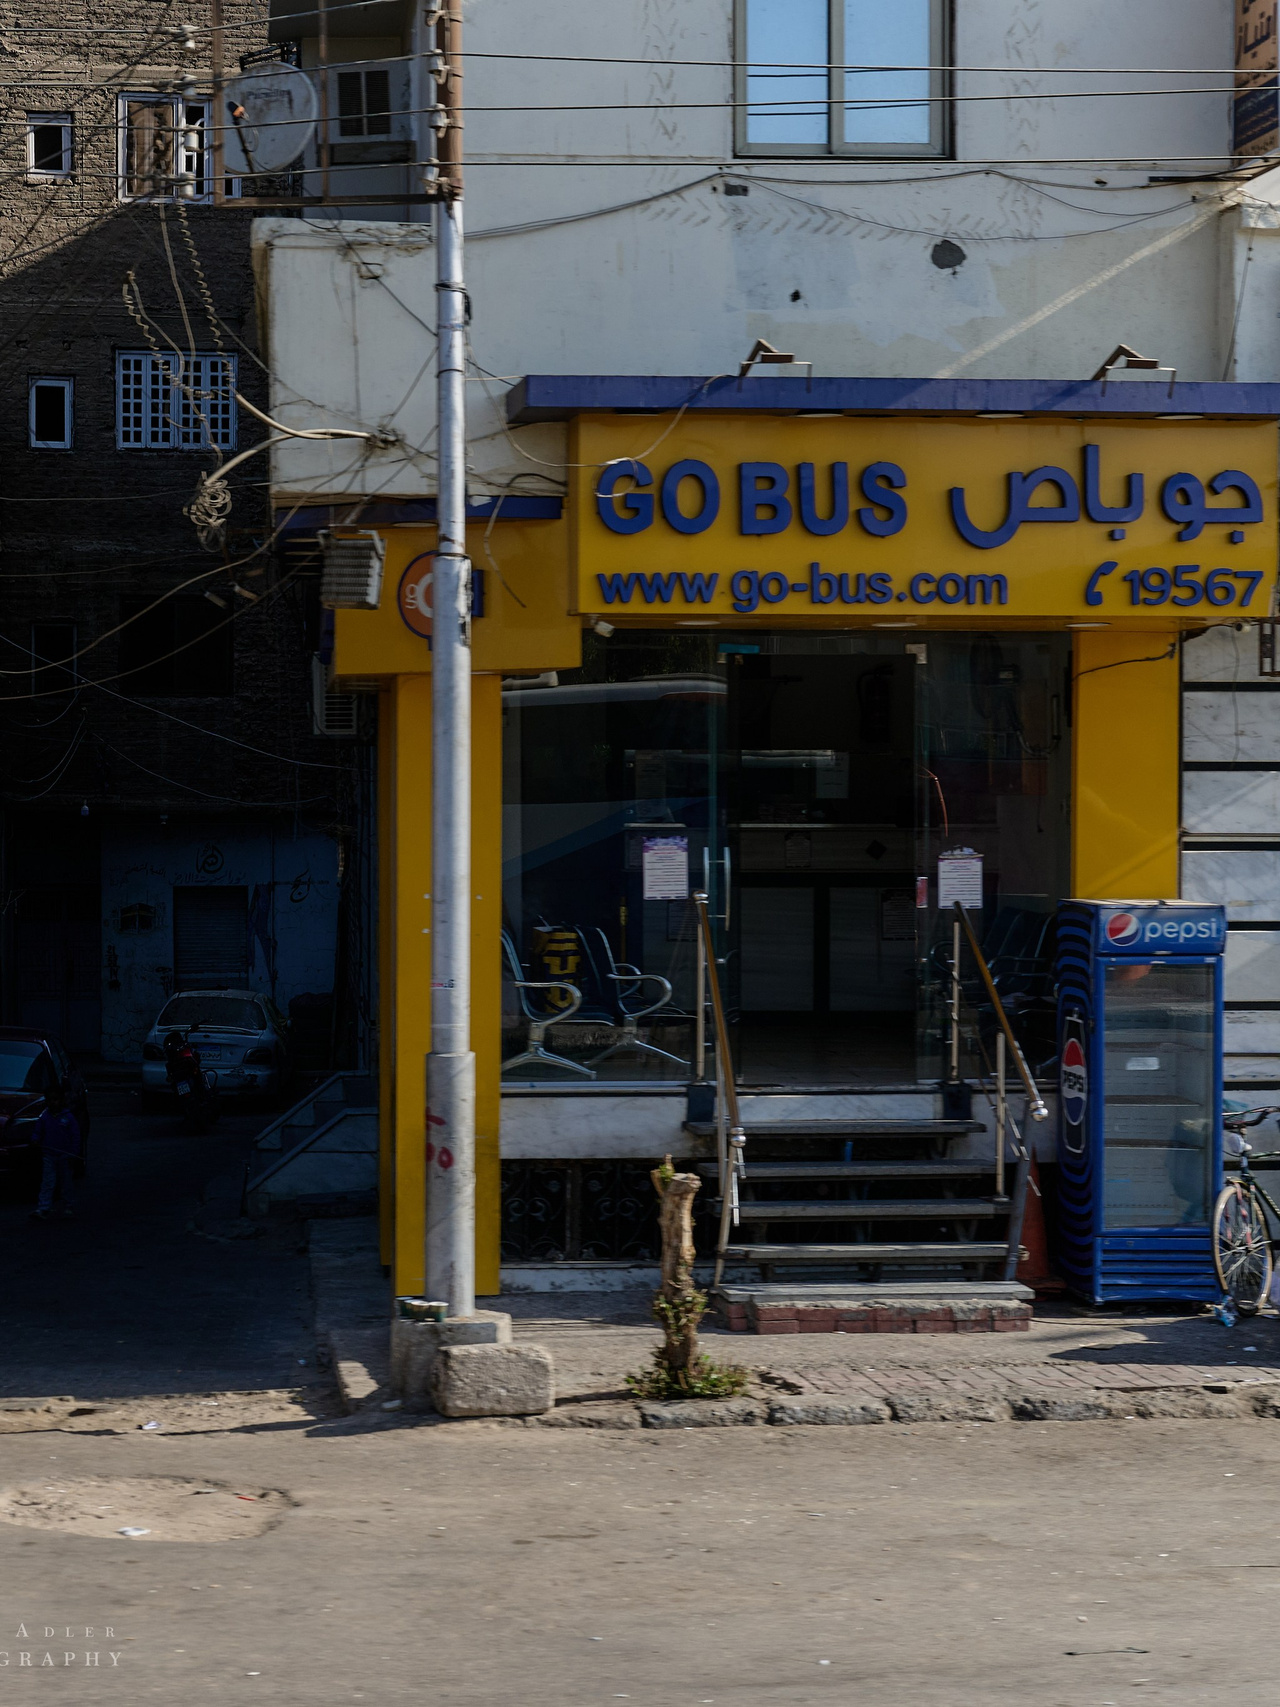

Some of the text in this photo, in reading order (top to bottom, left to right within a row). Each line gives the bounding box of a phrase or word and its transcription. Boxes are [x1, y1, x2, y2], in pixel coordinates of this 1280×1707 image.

[597, 459, 907, 536] GO BUS
[951, 445, 1263, 548] جو باص
[732, 561, 1007, 612] go-bus.com
[1124, 569, 1263, 606] 19567
[1144, 918, 1218, 943] pepsi
